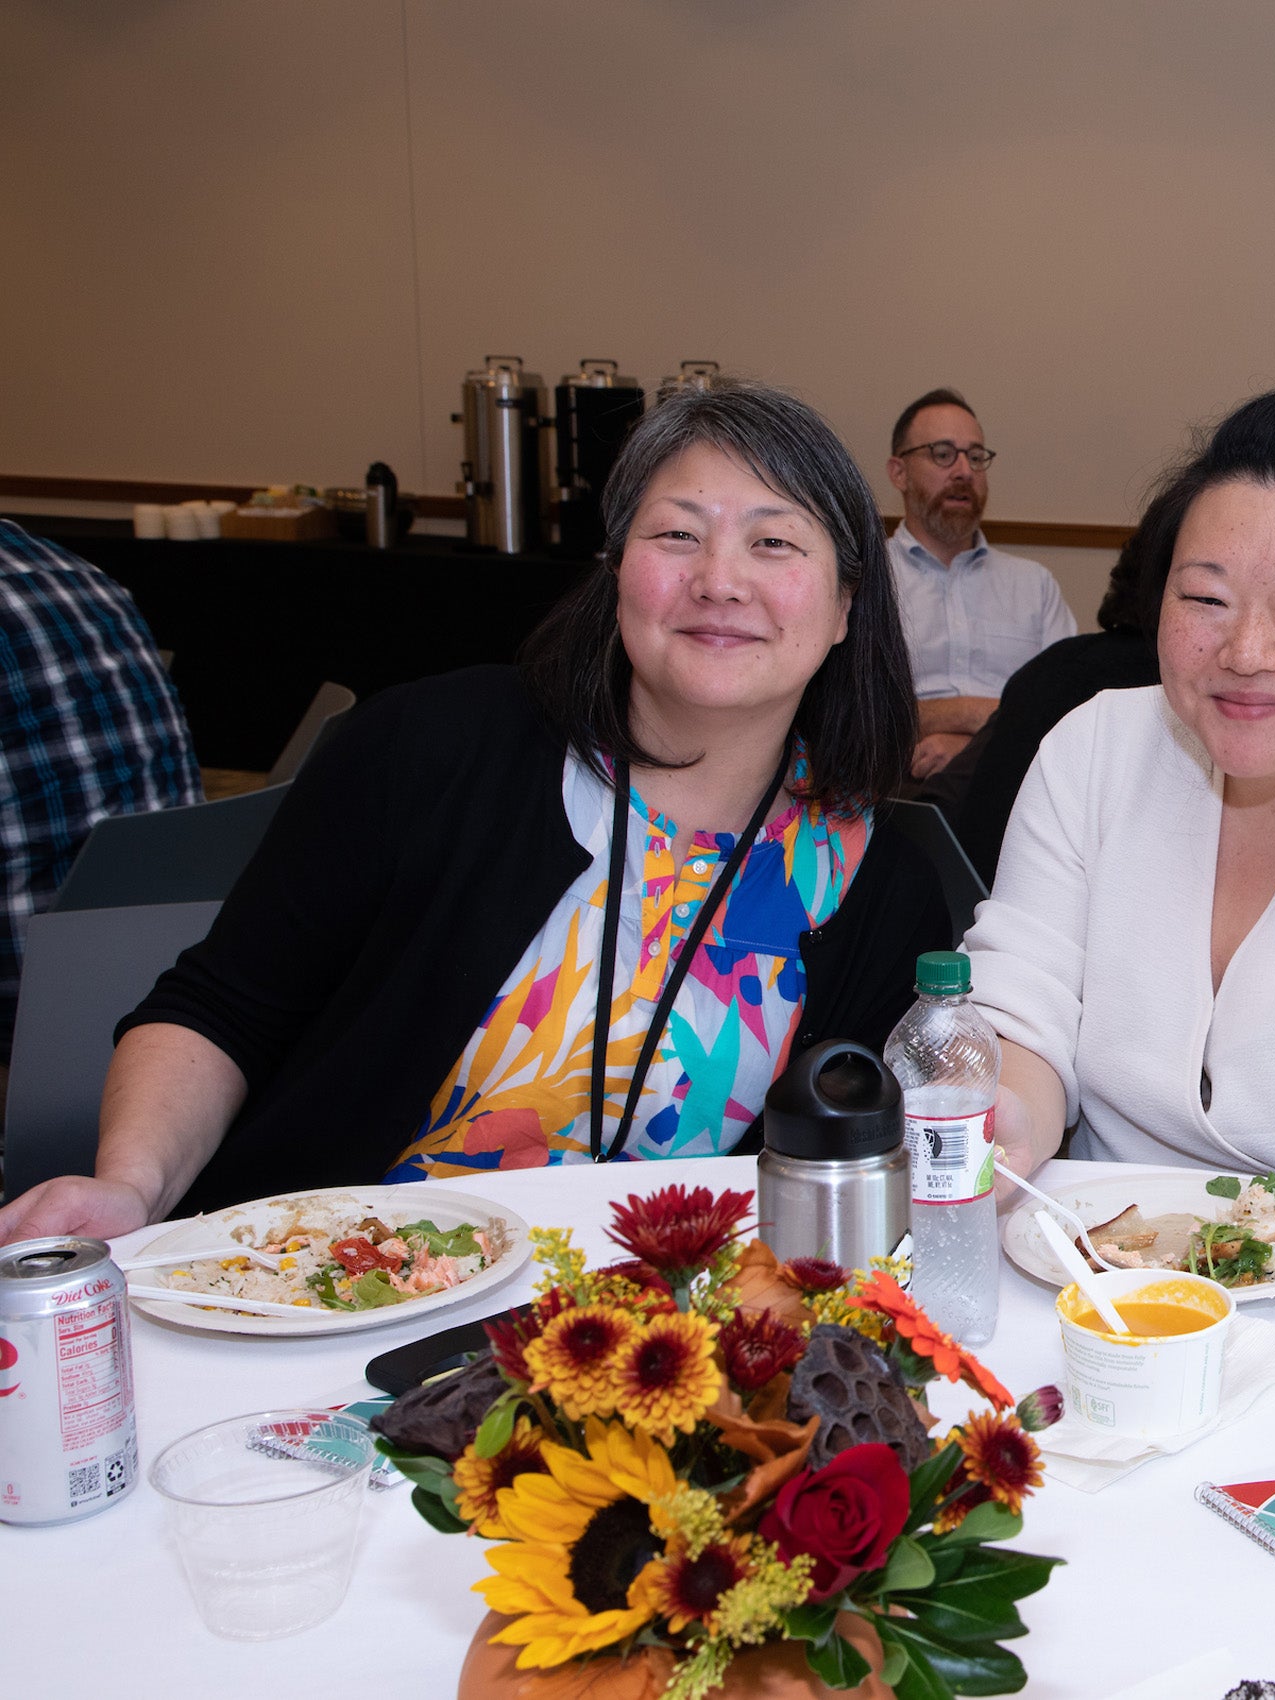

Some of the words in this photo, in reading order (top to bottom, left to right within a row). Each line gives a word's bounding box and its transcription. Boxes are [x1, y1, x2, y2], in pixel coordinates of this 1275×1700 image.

[52, 1289, 82, 1305] Diet
[84, 1279, 113, 1297] Coke
[58, 1310, 95, 1325] Nutrition
[60, 1340, 98, 1357] Calories
[112, 1326, 117, 1340] 0
